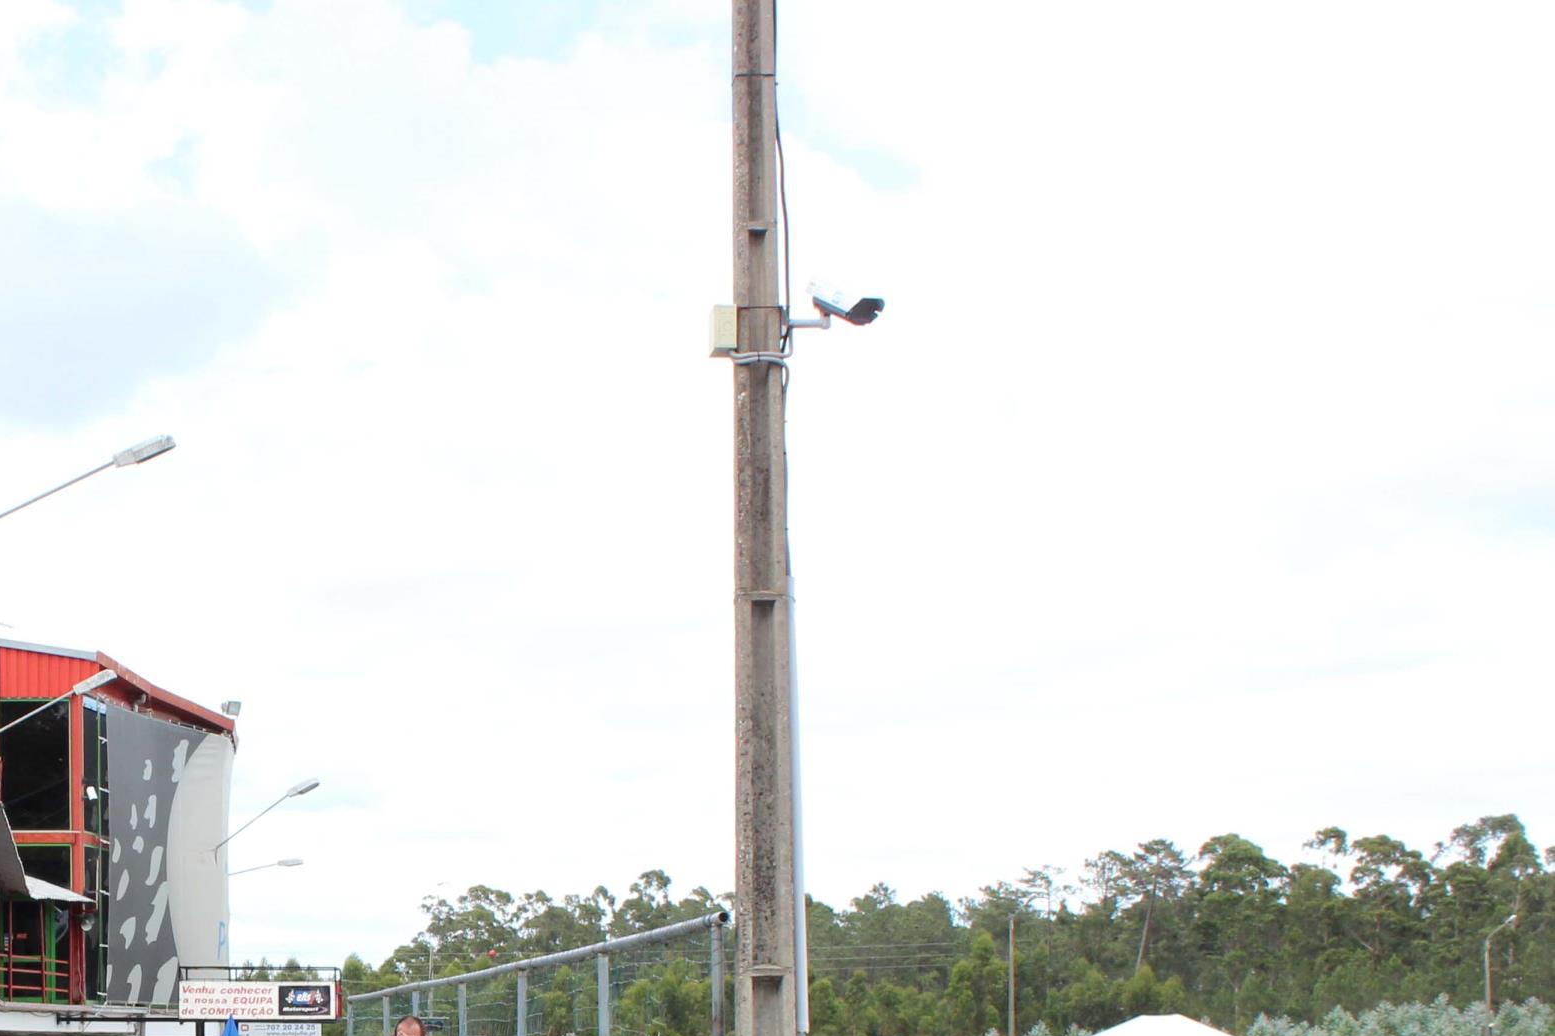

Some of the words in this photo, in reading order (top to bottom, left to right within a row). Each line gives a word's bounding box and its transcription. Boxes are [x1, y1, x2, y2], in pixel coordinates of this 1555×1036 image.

[182, 985, 216, 994] Venha
[220, 985, 273, 994] conhecer
[233, 996, 273, 1005] EQUIPA
[181, 1007, 194, 1016] de
[200, 1006, 274, 1017] COMPETIÇÃO
